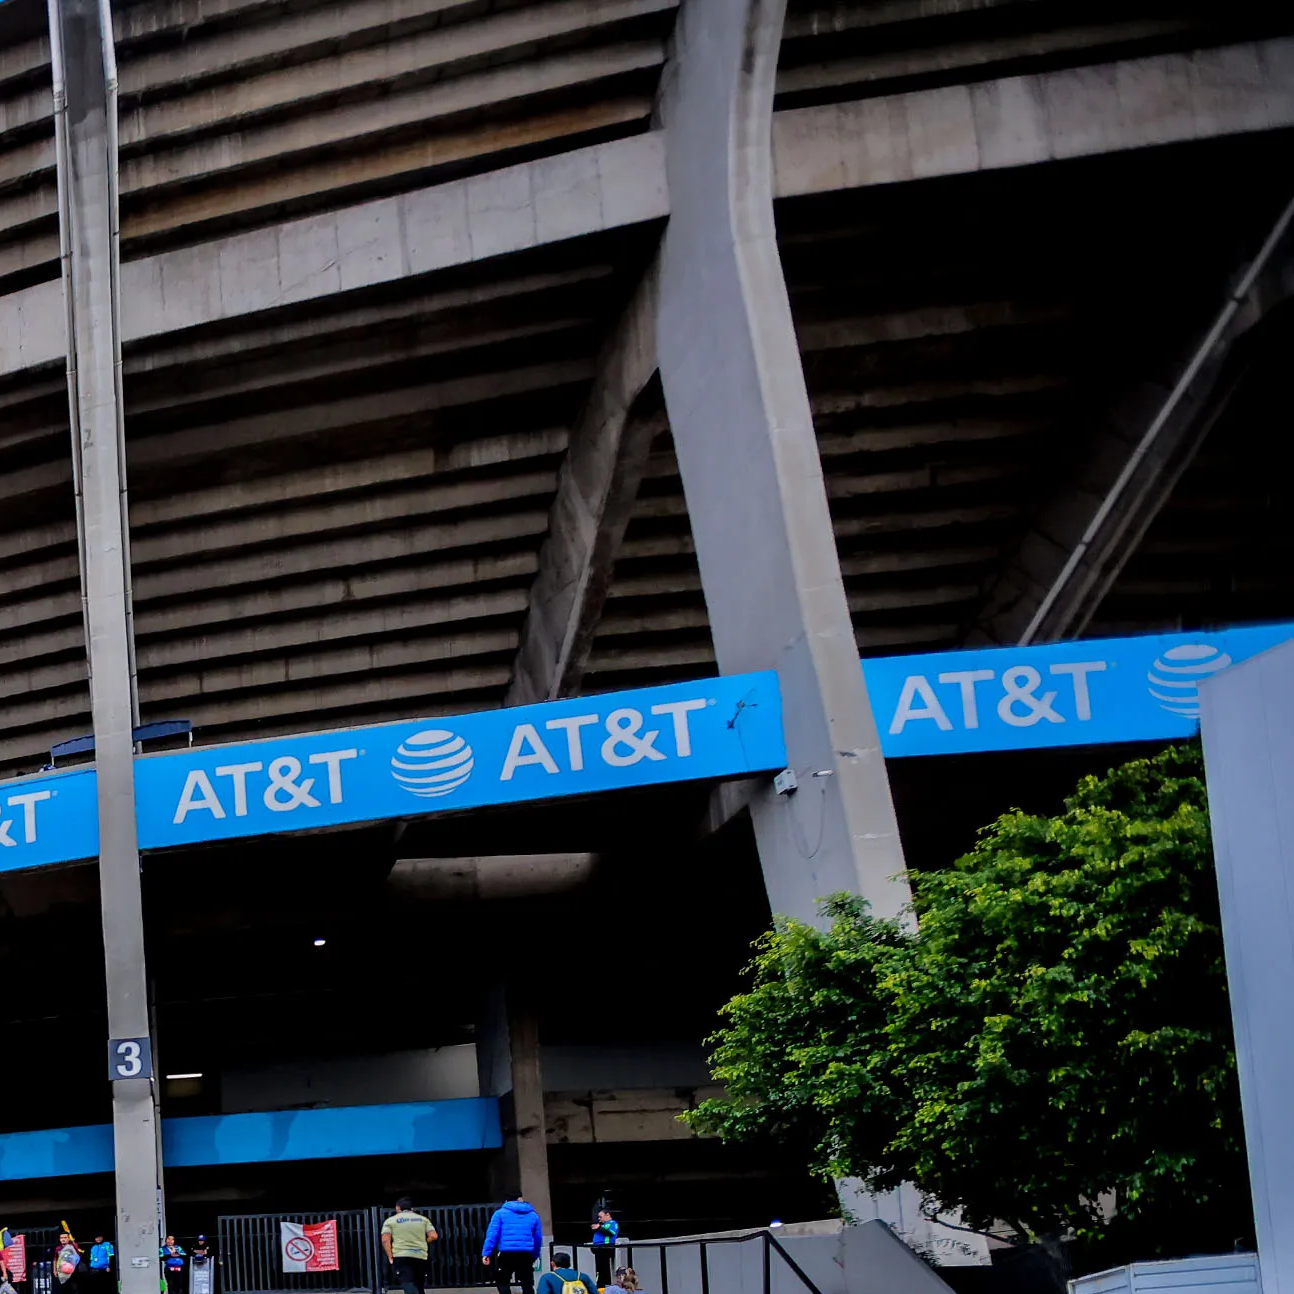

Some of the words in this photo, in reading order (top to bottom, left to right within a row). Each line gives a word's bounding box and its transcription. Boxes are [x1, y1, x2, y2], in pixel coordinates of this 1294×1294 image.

[888, 661, 1108, 735] AT&T
[172, 748, 358, 824] AT&T
[500, 698, 708, 781] AT&T
[116, 1041, 142, 1077] 3
